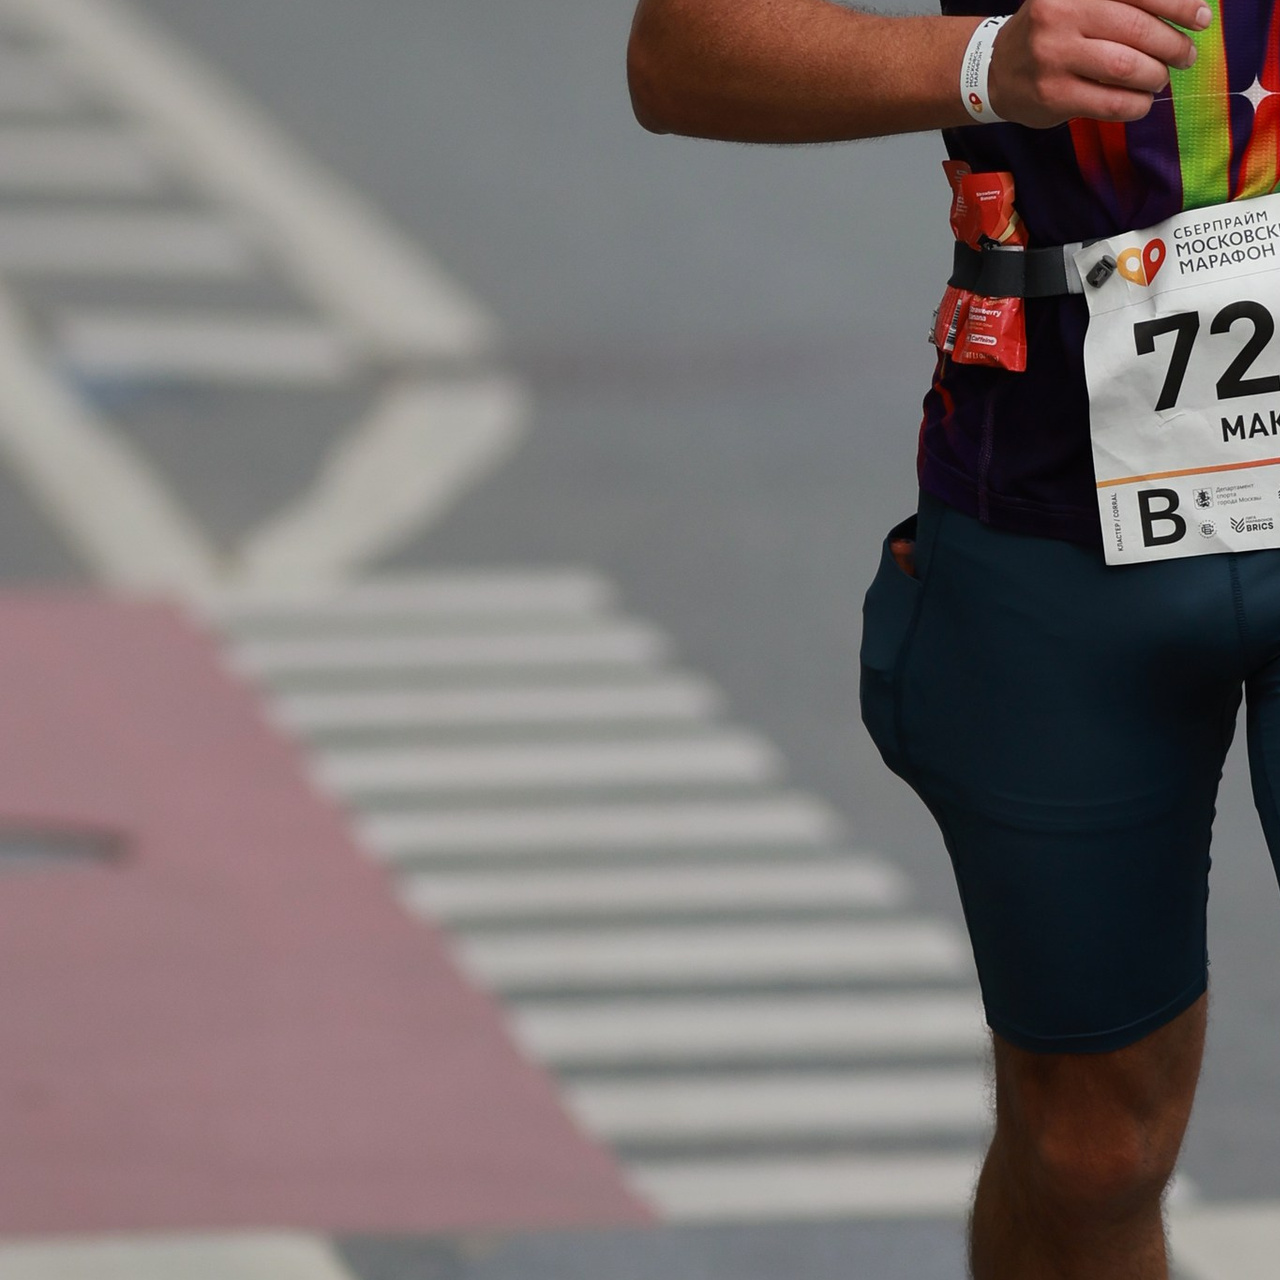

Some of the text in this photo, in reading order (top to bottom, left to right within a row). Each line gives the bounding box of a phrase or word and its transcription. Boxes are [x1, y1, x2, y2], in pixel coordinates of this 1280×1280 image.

[1173, 210, 1268, 239] СБЕРПРАЙМ
[1179, 242, 1276, 275] МАРАФОН
[1110, 492, 1119, 518] CORRAL
[1114, 523, 1123, 551] КЛАСТЕР
[1246, 521, 1274, 532] BRICS
